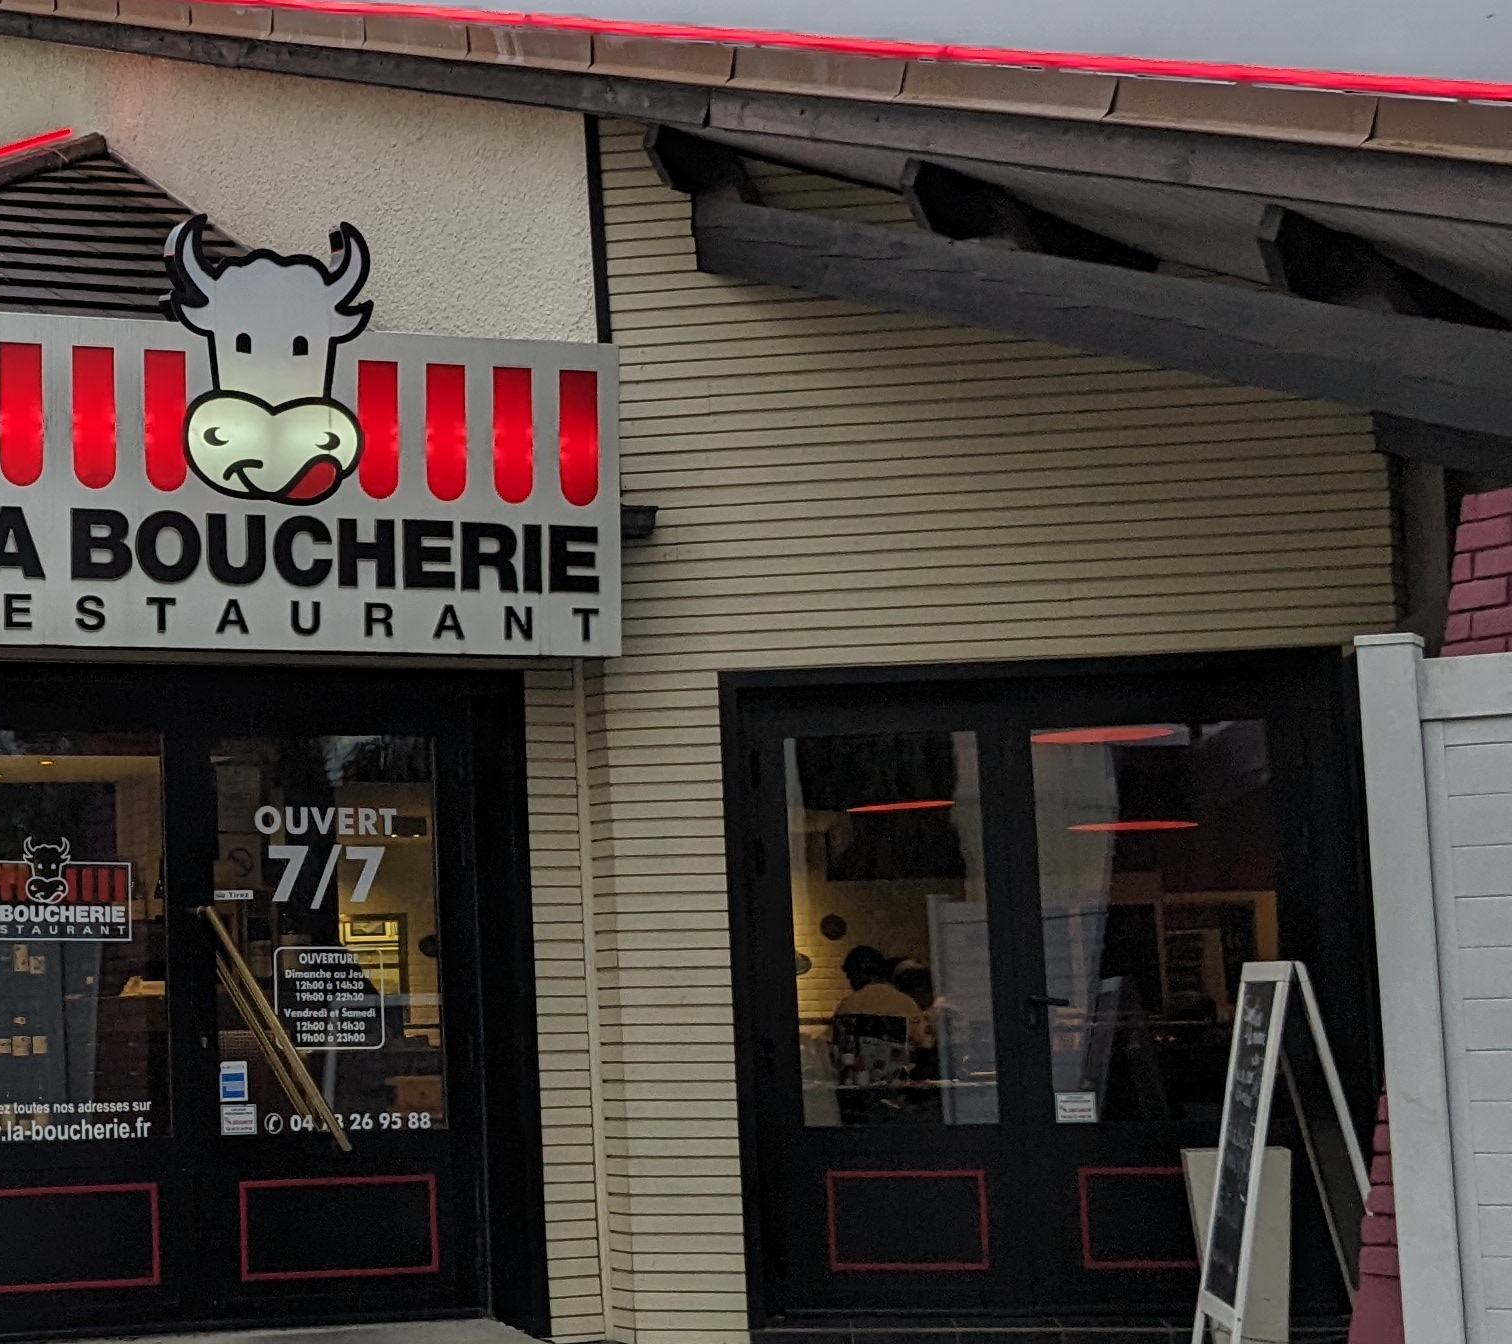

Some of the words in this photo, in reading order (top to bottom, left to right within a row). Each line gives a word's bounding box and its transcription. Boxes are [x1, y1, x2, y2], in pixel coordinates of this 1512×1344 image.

[70, 506, 600, 594] BOUCHERIE
[254, 806, 397, 836] OUVERT
[268, 844, 385, 909] 7/7
[0, 905, 126, 923] BOUCHERIE
[299, 953, 359, 964] OUVERTURE
[285, 969, 332, 978] Dimanche
[295, 981, 324, 989] 12h00
[326, 981, 333, 989] à
[335, 981, 364, 989] 14h30
[295, 993, 324, 1001] 19h00
[326, 993, 333, 1001] à
[335, 993, 364, 1001] 22h30
[283, 1008, 327, 1017] Vendredi
[329, 1009, 339, 1017] et
[341, 1008, 376, 1017] Samedi
[296, 1022, 325, 1030] 12h00
[327, 1022, 333, 1030] à
[336, 1022, 365, 1030] 14h30
[296, 1033, 325, 1042] 19h00
[327, 1033, 334, 1042] à
[336, 1033, 365, 1042] 23h00
[13, 1102, 49, 1114] toutes
[53, 1103, 74, 1114] nos
[77, 1100, 129, 1113] adresses
[132, 1100, 151, 1111] sur
[290, 1114, 314, 1132] 04
[350, 1113, 373, 1130] 26
[379, 1112, 402, 1130] 95
[408, 1112, 431, 1129] 88
